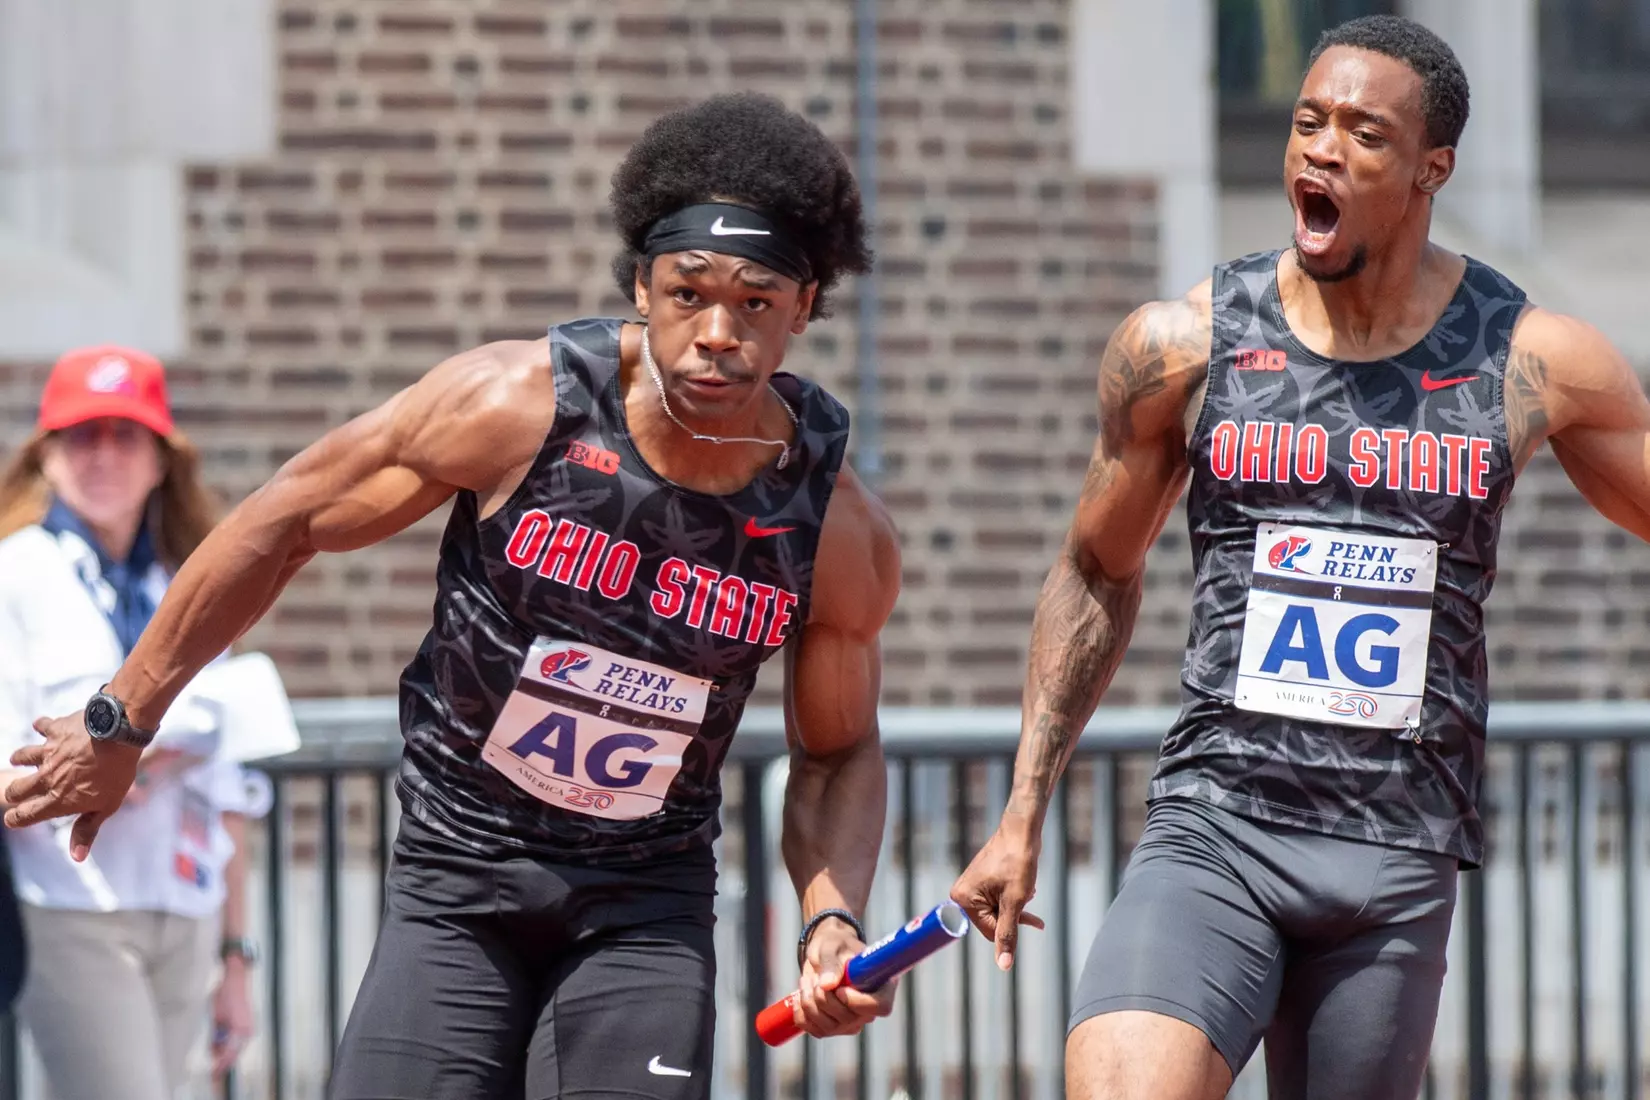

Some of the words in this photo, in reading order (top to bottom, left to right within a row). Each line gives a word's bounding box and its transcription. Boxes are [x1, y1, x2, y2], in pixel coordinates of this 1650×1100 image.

[1210, 420, 1329, 485] OHIO
[1348, 427, 1492, 500] STATE
[1321, 560, 1416, 584] RELAYS
[1326, 541, 1398, 563] PENN
[505, 508, 641, 600] OHIO
[650, 557, 798, 647] STATE
[1259, 604, 1401, 688] AG
[593, 678, 688, 714] RELAYS
[603, 662, 676, 693] PENN
[1327, 691, 1378, 719] 250
[507, 711, 660, 788] AG
[515, 766, 564, 797] AMERICA
[564, 786, 615, 811] 250
